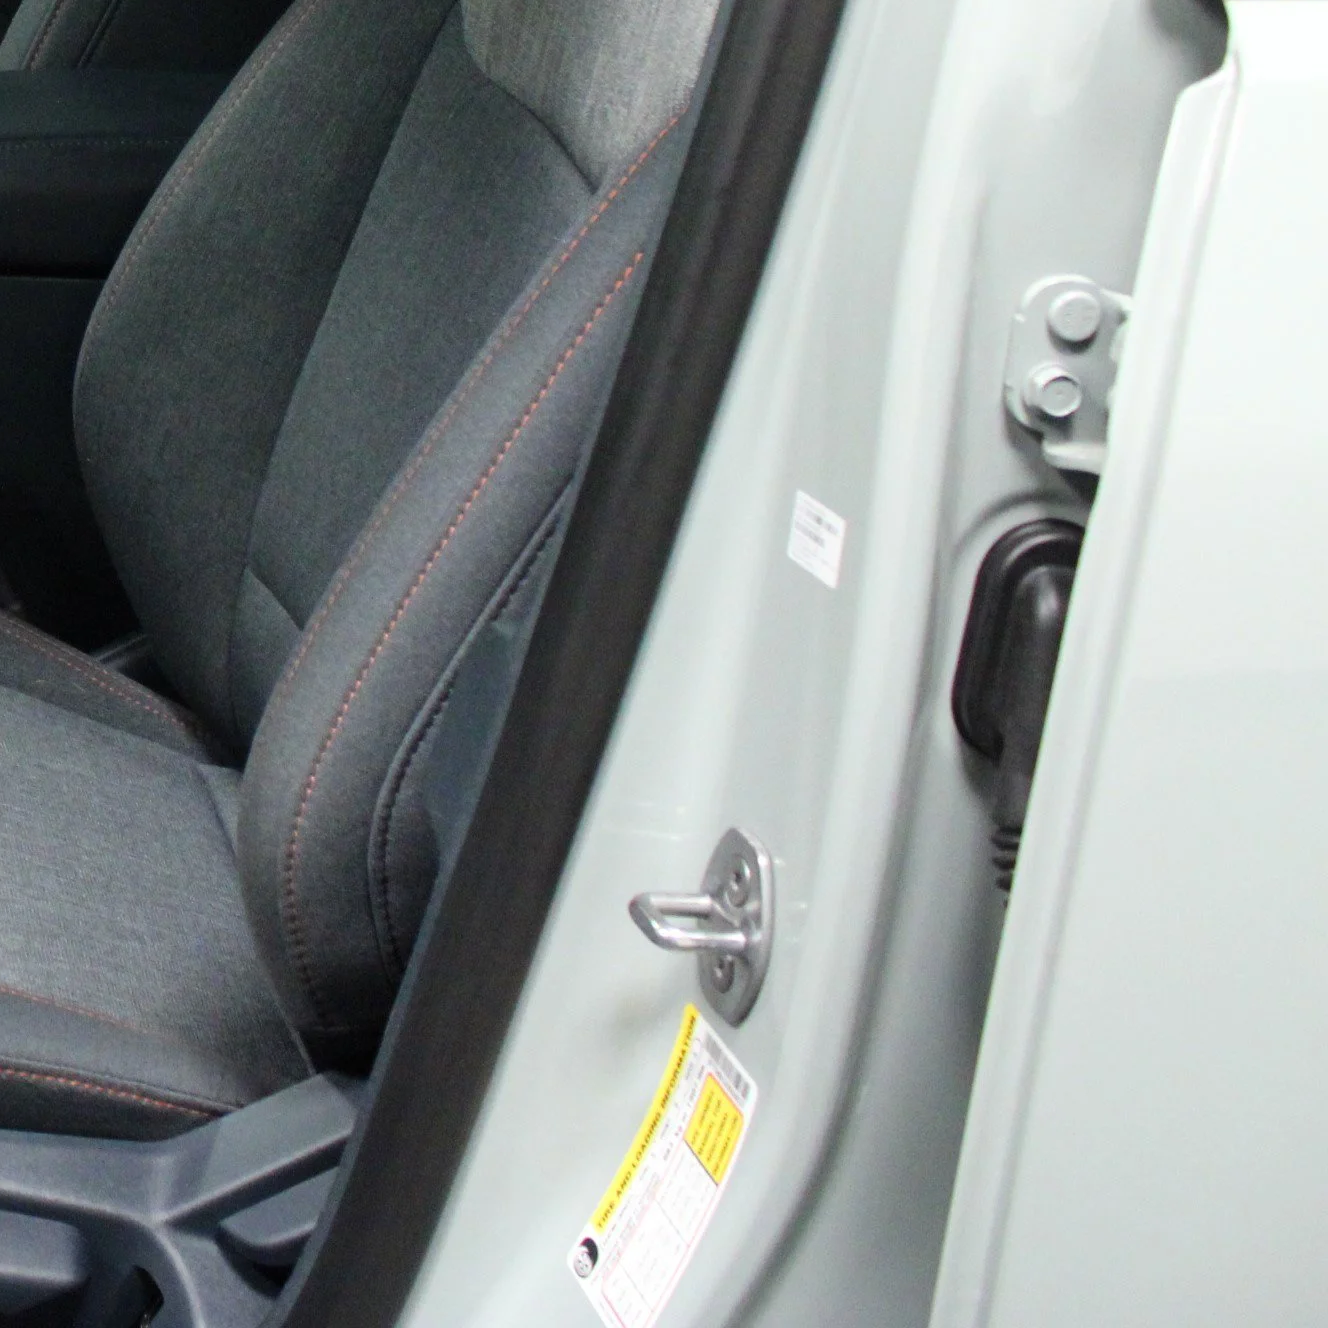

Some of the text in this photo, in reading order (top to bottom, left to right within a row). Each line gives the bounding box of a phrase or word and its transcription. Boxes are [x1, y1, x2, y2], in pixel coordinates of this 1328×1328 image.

[596, 1199, 615, 1229] TIRE
[616, 1170, 632, 1199] AND
[631, 1111, 662, 1170] LOADING
[660, 1015, 697, 1109] INFORMATION
